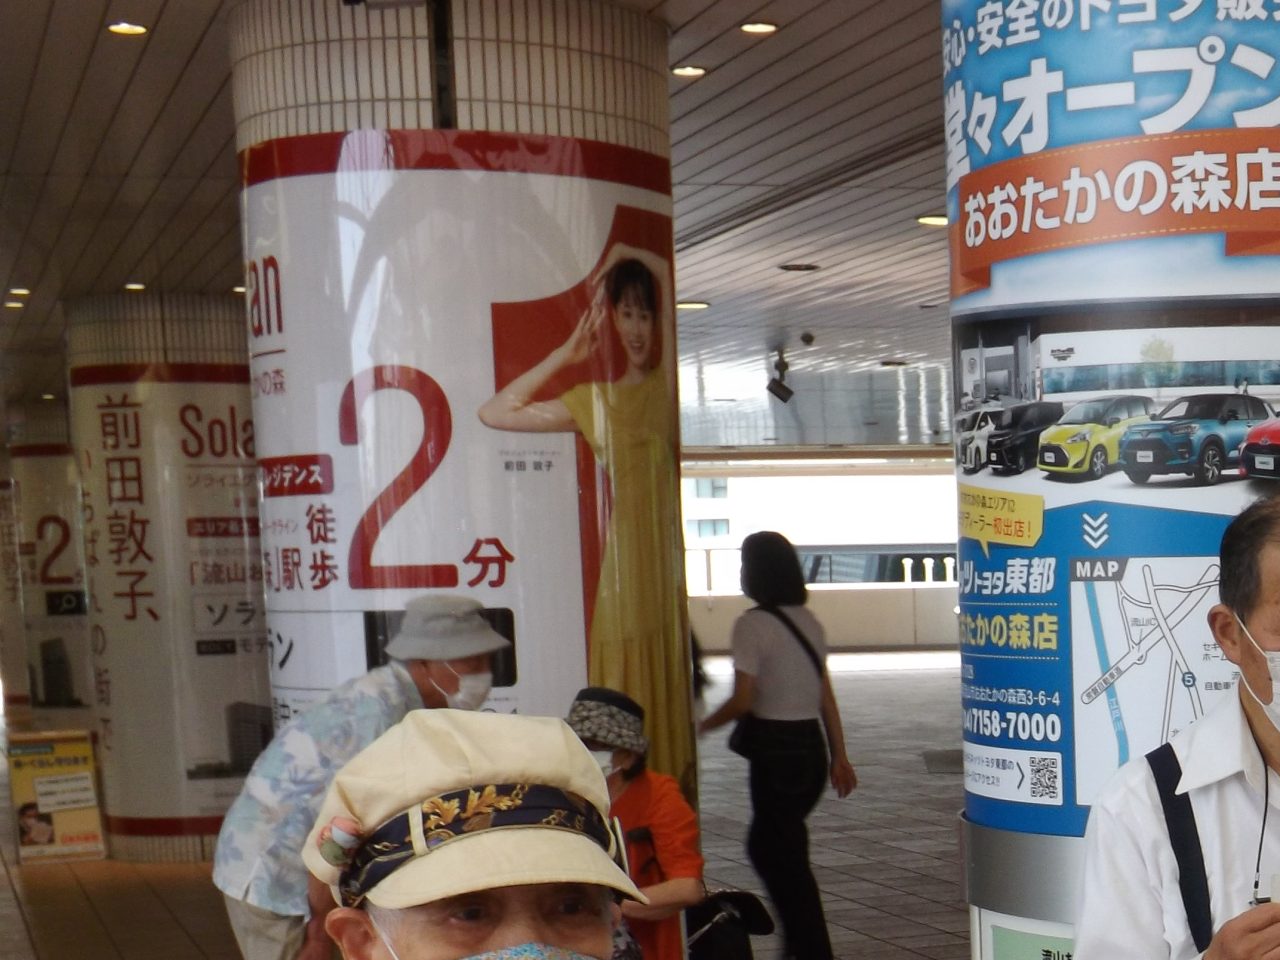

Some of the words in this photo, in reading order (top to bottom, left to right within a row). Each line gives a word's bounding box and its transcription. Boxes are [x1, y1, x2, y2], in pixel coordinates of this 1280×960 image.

[339, 364, 453, 590] 2
[463, 537, 515, 588] 分
[1076, 560, 1119, 578] MAP
[1184, 673, 1194, 688] 5
